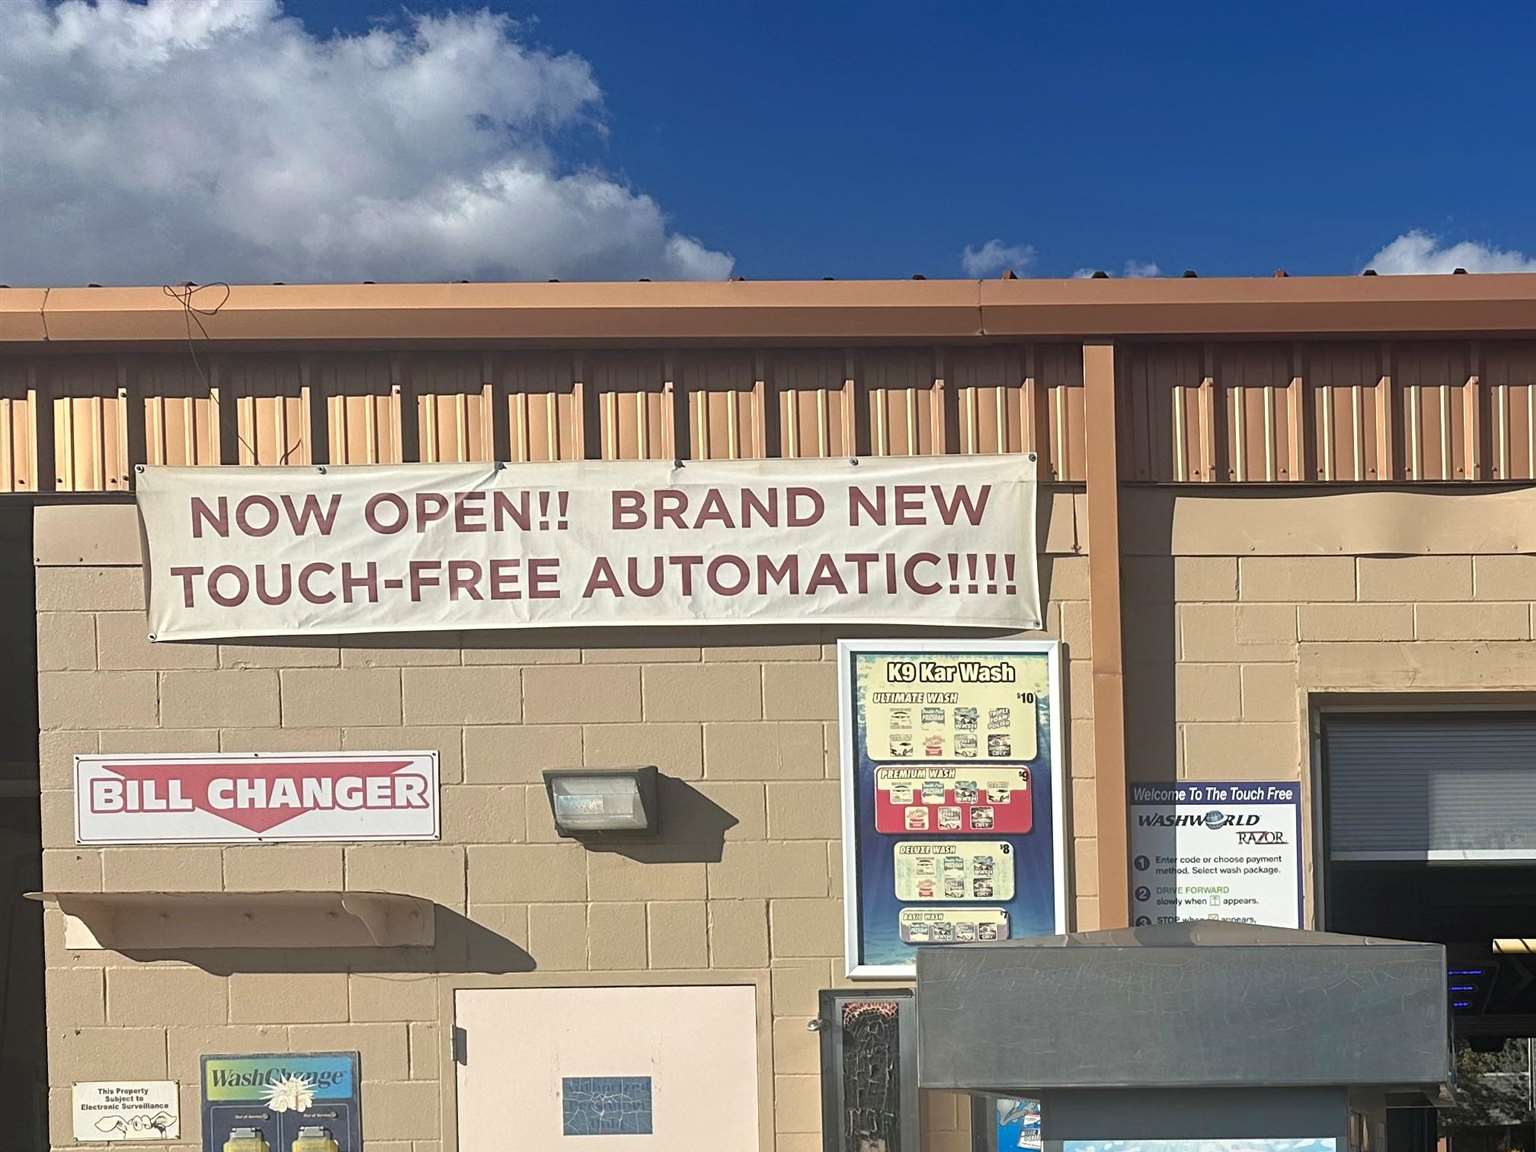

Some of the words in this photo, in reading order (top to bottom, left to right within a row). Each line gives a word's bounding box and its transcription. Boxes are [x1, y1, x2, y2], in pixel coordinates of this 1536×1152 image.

[190, 493, 342, 538] NOW
[365, 491, 569, 535] OPEN!!
[612, 487, 825, 530] BRAND
[848, 484, 992, 527] NEW
[170, 557, 561, 608] TOUCH-FREE
[582, 552, 1017, 598] AUTOMATIC!!!!
[887, 662, 916, 682] K9
[920, 662, 956, 682] Kar
[957, 662, 1015, 682] Wash
[873, 692, 924, 703] ULTIMATE
[926, 692, 958, 703] WASH
[1017, 693, 1034, 704] $10
[880, 768, 927, 779] PREMIUM
[928, 768, 956, 779] WASH
[90, 777, 194, 813] BILL
[207, 773, 430, 811] CHANGER
[1134, 787, 1186, 801] Welcome
[1189, 787, 1203, 801] To
[1205, 787, 1227, 801] The
[1230, 787, 1264, 801] Touch
[1267, 787, 1293, 800] Free
[1236, 831, 1289, 845] RAZOR
[899, 845, 931, 854] DELUXE
[932, 845, 956, 854] WASH
[1000, 844, 1010, 854] $8
[1155, 856, 1177, 864] Enter
[1180, 856, 1200, 864] code
[1246, 856, 1282, 866] payment
[1155, 867, 1189, 875] method.
[1243, 867, 1281, 876] package.
[1156, 886, 1183, 894] DRIVE
[1185, 886, 1229, 894] FORWARD
[1156, 897, 1183, 906] slowly
[1157, 916, 1181, 925] STOP
[116, 1087, 148, 1096] Property
[105, 1095, 134, 1103] Subject
